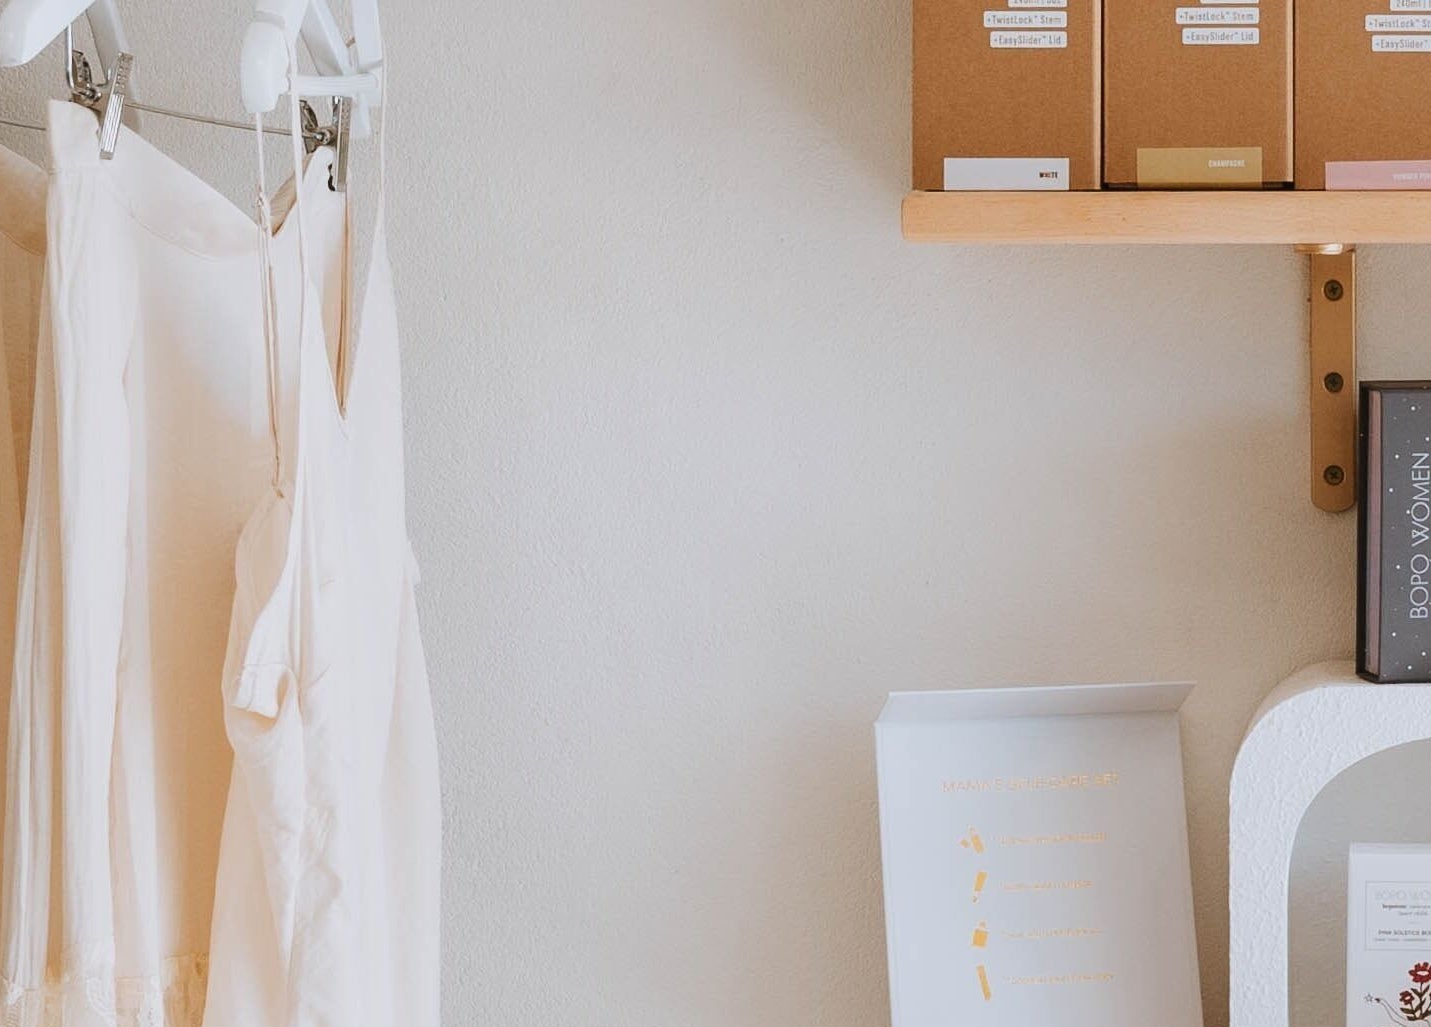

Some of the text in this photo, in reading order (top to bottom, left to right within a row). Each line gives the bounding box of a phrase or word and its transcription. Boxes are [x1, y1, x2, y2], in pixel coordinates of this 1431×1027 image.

[1038, 171, 1059, 179] WHITE
[1409, 451, 1431, 620] BOPO WOMEN
